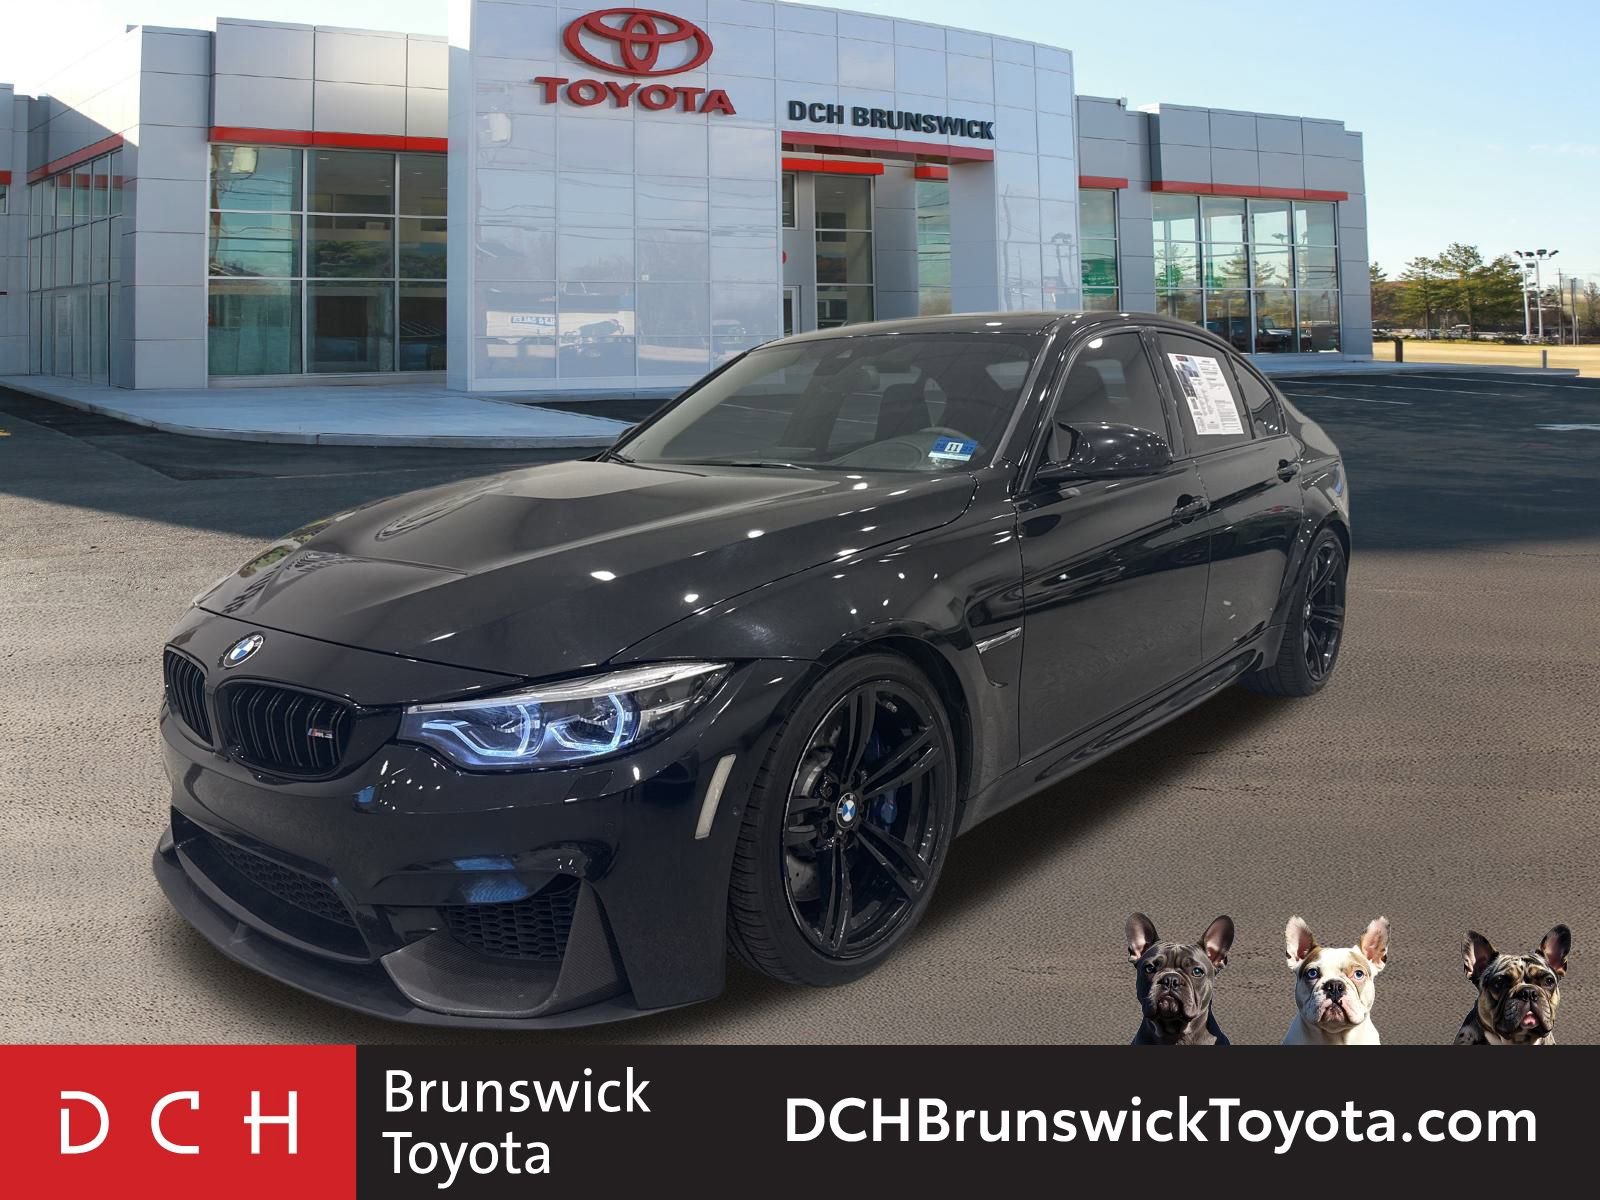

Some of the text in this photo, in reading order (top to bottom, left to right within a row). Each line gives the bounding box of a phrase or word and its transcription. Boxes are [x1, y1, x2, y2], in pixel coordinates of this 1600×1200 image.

[535, 76, 736, 115] TOYOTA
[788, 100, 995, 140] DCH BRUNSWICK
